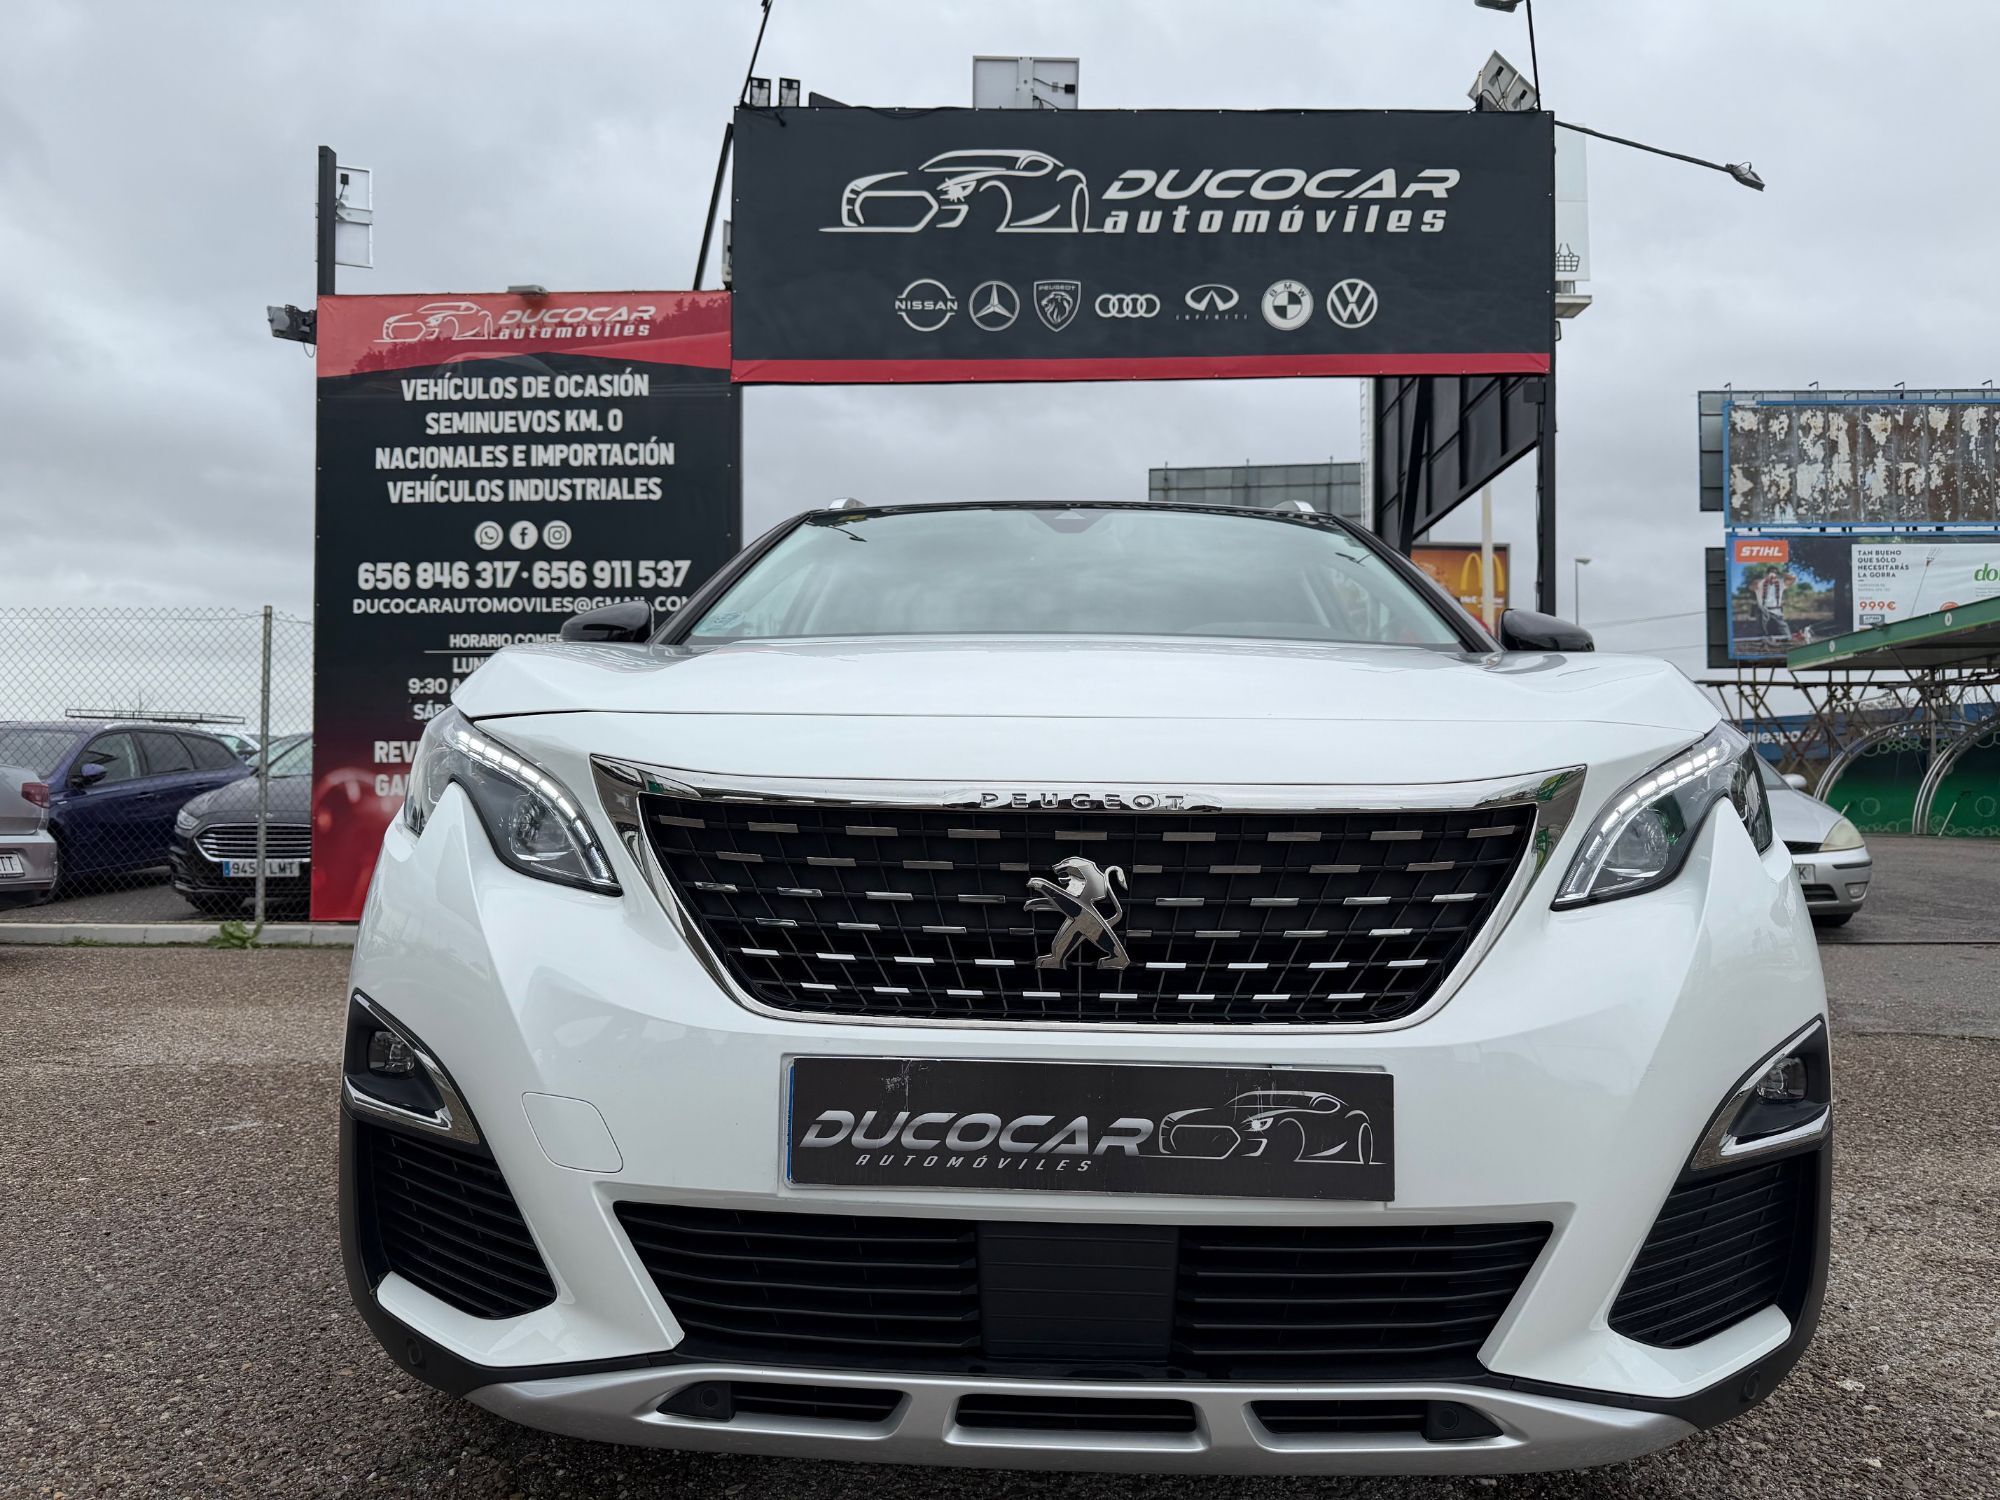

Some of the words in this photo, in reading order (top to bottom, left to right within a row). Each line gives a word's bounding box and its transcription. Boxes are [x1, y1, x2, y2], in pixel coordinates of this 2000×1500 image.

[1101, 167, 1461, 200] DUCOCAR
[1103, 204, 1447, 233] automóviles
[895, 300, 958, 310] NISSAN
[498, 306, 657, 324] DUCOCAR
[498, 322, 651, 340] automóviles
[401, 372, 518, 401] VEHÍCULOS
[522, 375, 550, 399] DE
[554, 368, 650, 398] OCASIÓN
[425, 409, 561, 435] SEMINUEVOS
[565, 409, 604, 432] KM.
[375, 444, 508, 470] NACIONALES
[512, 445, 527, 467] E
[530, 437, 675, 467] IMPORTACIÓN
[387, 474, 504, 504] VEHÍCULOS
[508, 477, 663, 502] INDUSTRIALES
[1740, 546, 1782, 556] STIHL
[357, 562, 411, 591] 656
[415, 561, 470, 590] 846
[593, 560, 632, 589] 911
[637, 560, 692, 588] 537
[1974, 563, 2000, 581] do
[1859, 600, 1897, 611] 999€
[449, 634, 512, 648] HORARIO
[453, 657, 489, 674] LUN
[408, 677, 448, 694] 9:30
[374, 740, 420, 763] REV
[980, 792, 1185, 811] PEUGEOT
[231, 861, 258, 875] 945
[269, 861, 296, 875] LMT
[799, 1109, 1155, 1155] DUCOCAR
[855, 1154, 1092, 1173] AUTOMÓVILES
